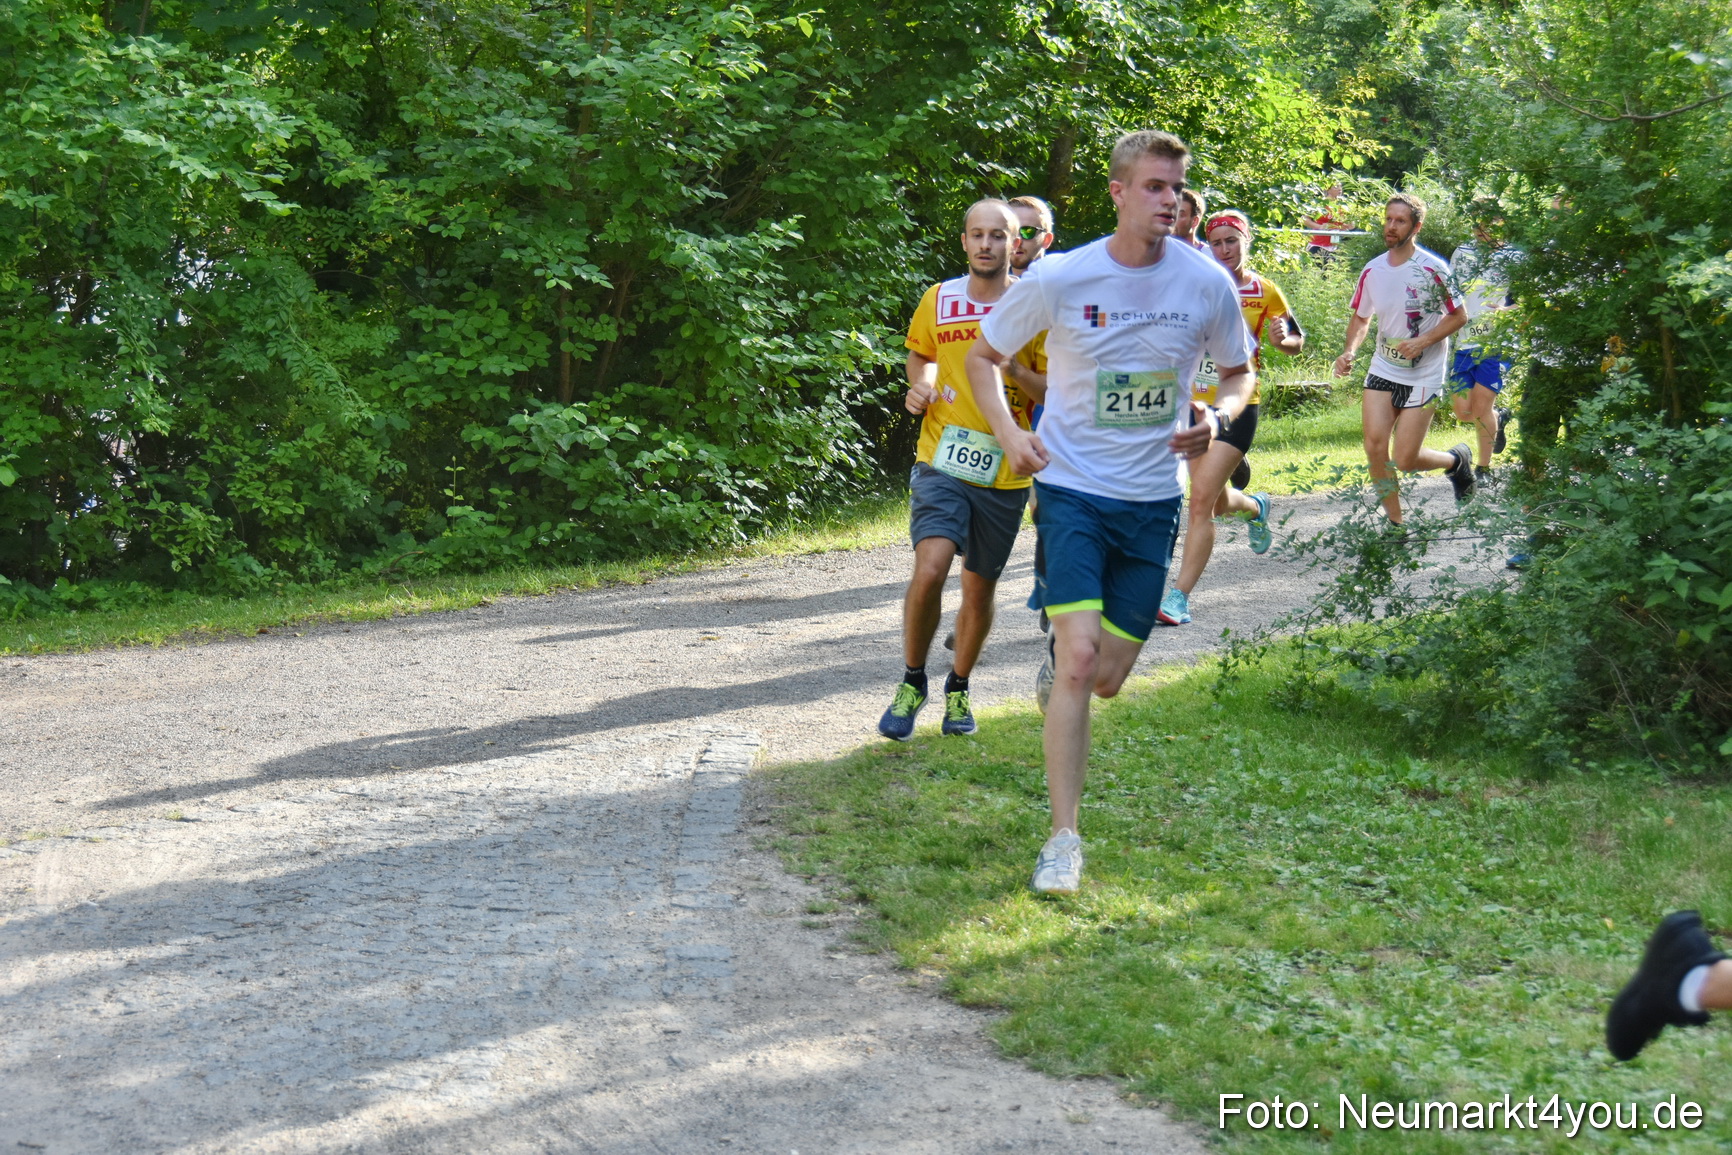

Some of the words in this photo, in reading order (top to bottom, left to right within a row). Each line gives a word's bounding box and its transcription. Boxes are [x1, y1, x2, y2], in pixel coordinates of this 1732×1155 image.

[1241, 299, 1263, 309] ÖGL
[1110, 312, 1189, 322] SCHWARZ
[937, 328, 977, 344] MAX
[1199, 360, 1218, 374] 15
[1106, 389, 1167, 412] 2144
[946, 443, 993, 471] 1699
